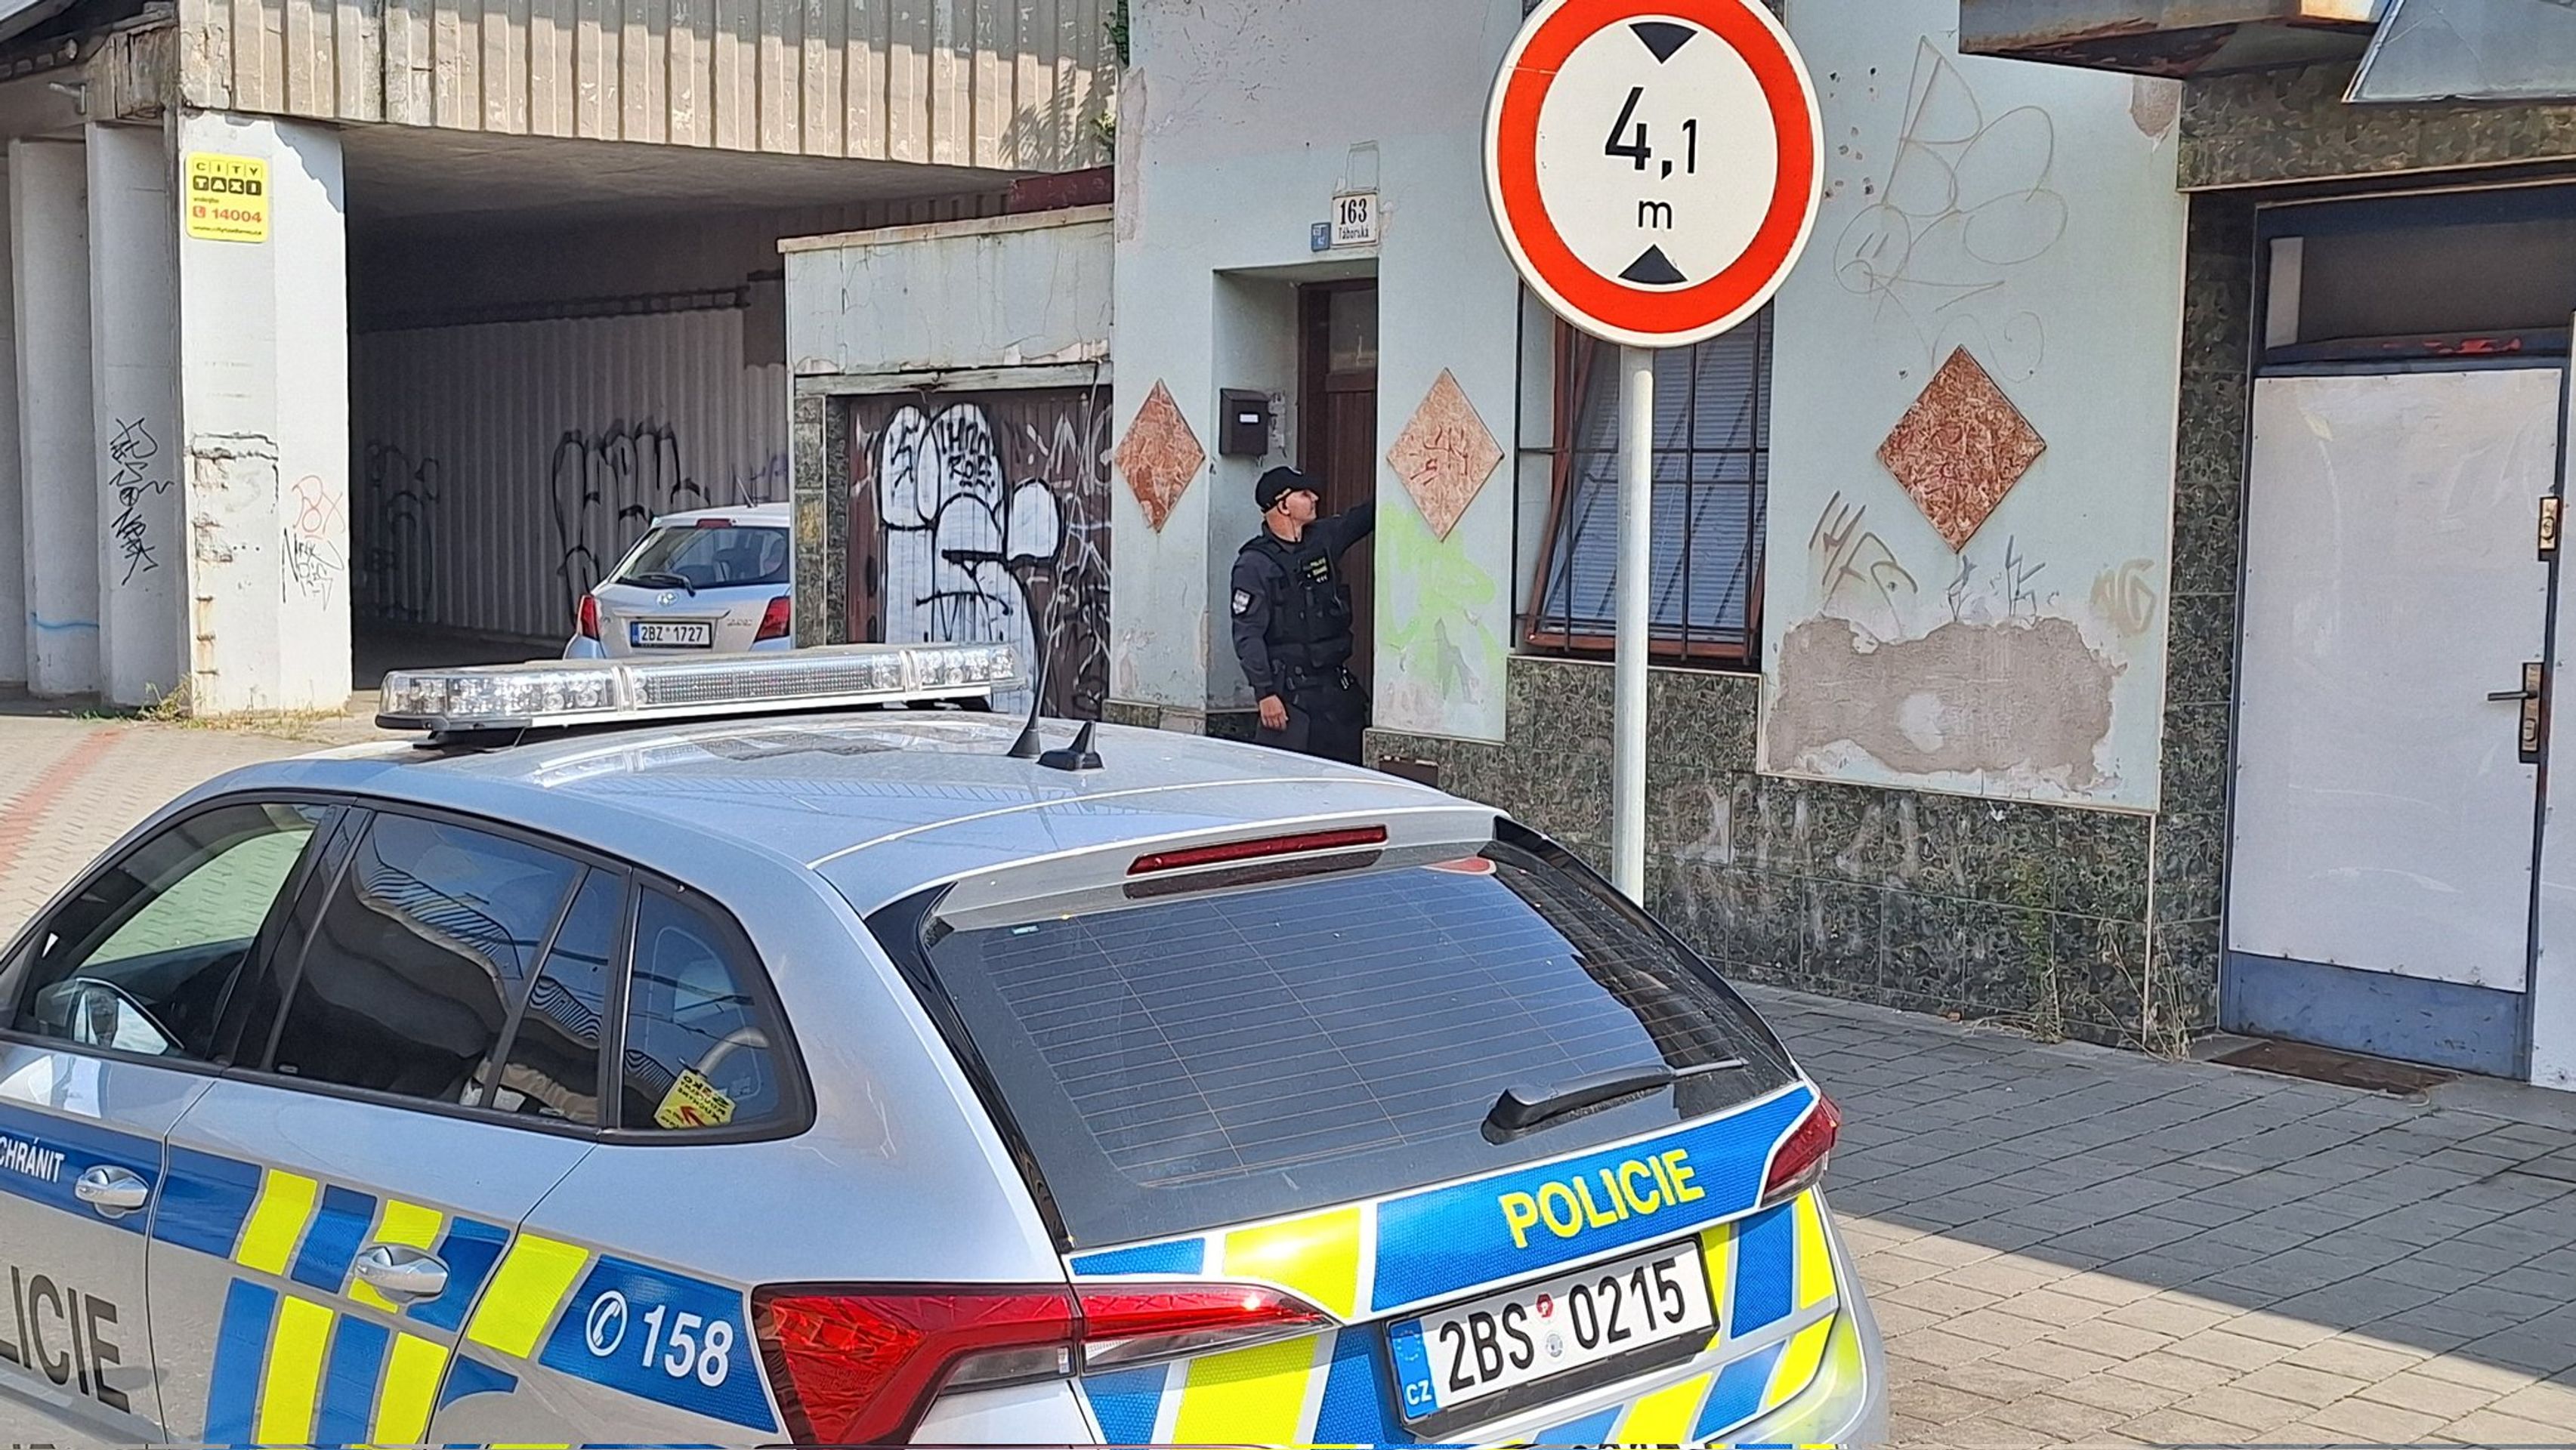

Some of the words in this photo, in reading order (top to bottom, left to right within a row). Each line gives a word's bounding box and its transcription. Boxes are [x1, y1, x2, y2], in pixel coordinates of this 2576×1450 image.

[1605, 87, 1697, 180] 4,1
[196, 162, 258, 175] CITY
[193, 175, 261, 196] TAXI
[212, 208, 261, 223] 14004
[1340, 198, 1367, 224] 163
[1638, 200, 1672, 229] m
[641, 626, 663, 641] 2BZ
[673, 626, 703, 641] 1727
[1499, 1149, 1705, 1248] POLICIE
[1439, 1303, 1535, 1393] 2BS
[1569, 1259, 1685, 1350] 0215
[641, 1303, 734, 1387] 158
[1406, 1380, 1432, 1405] CZ
